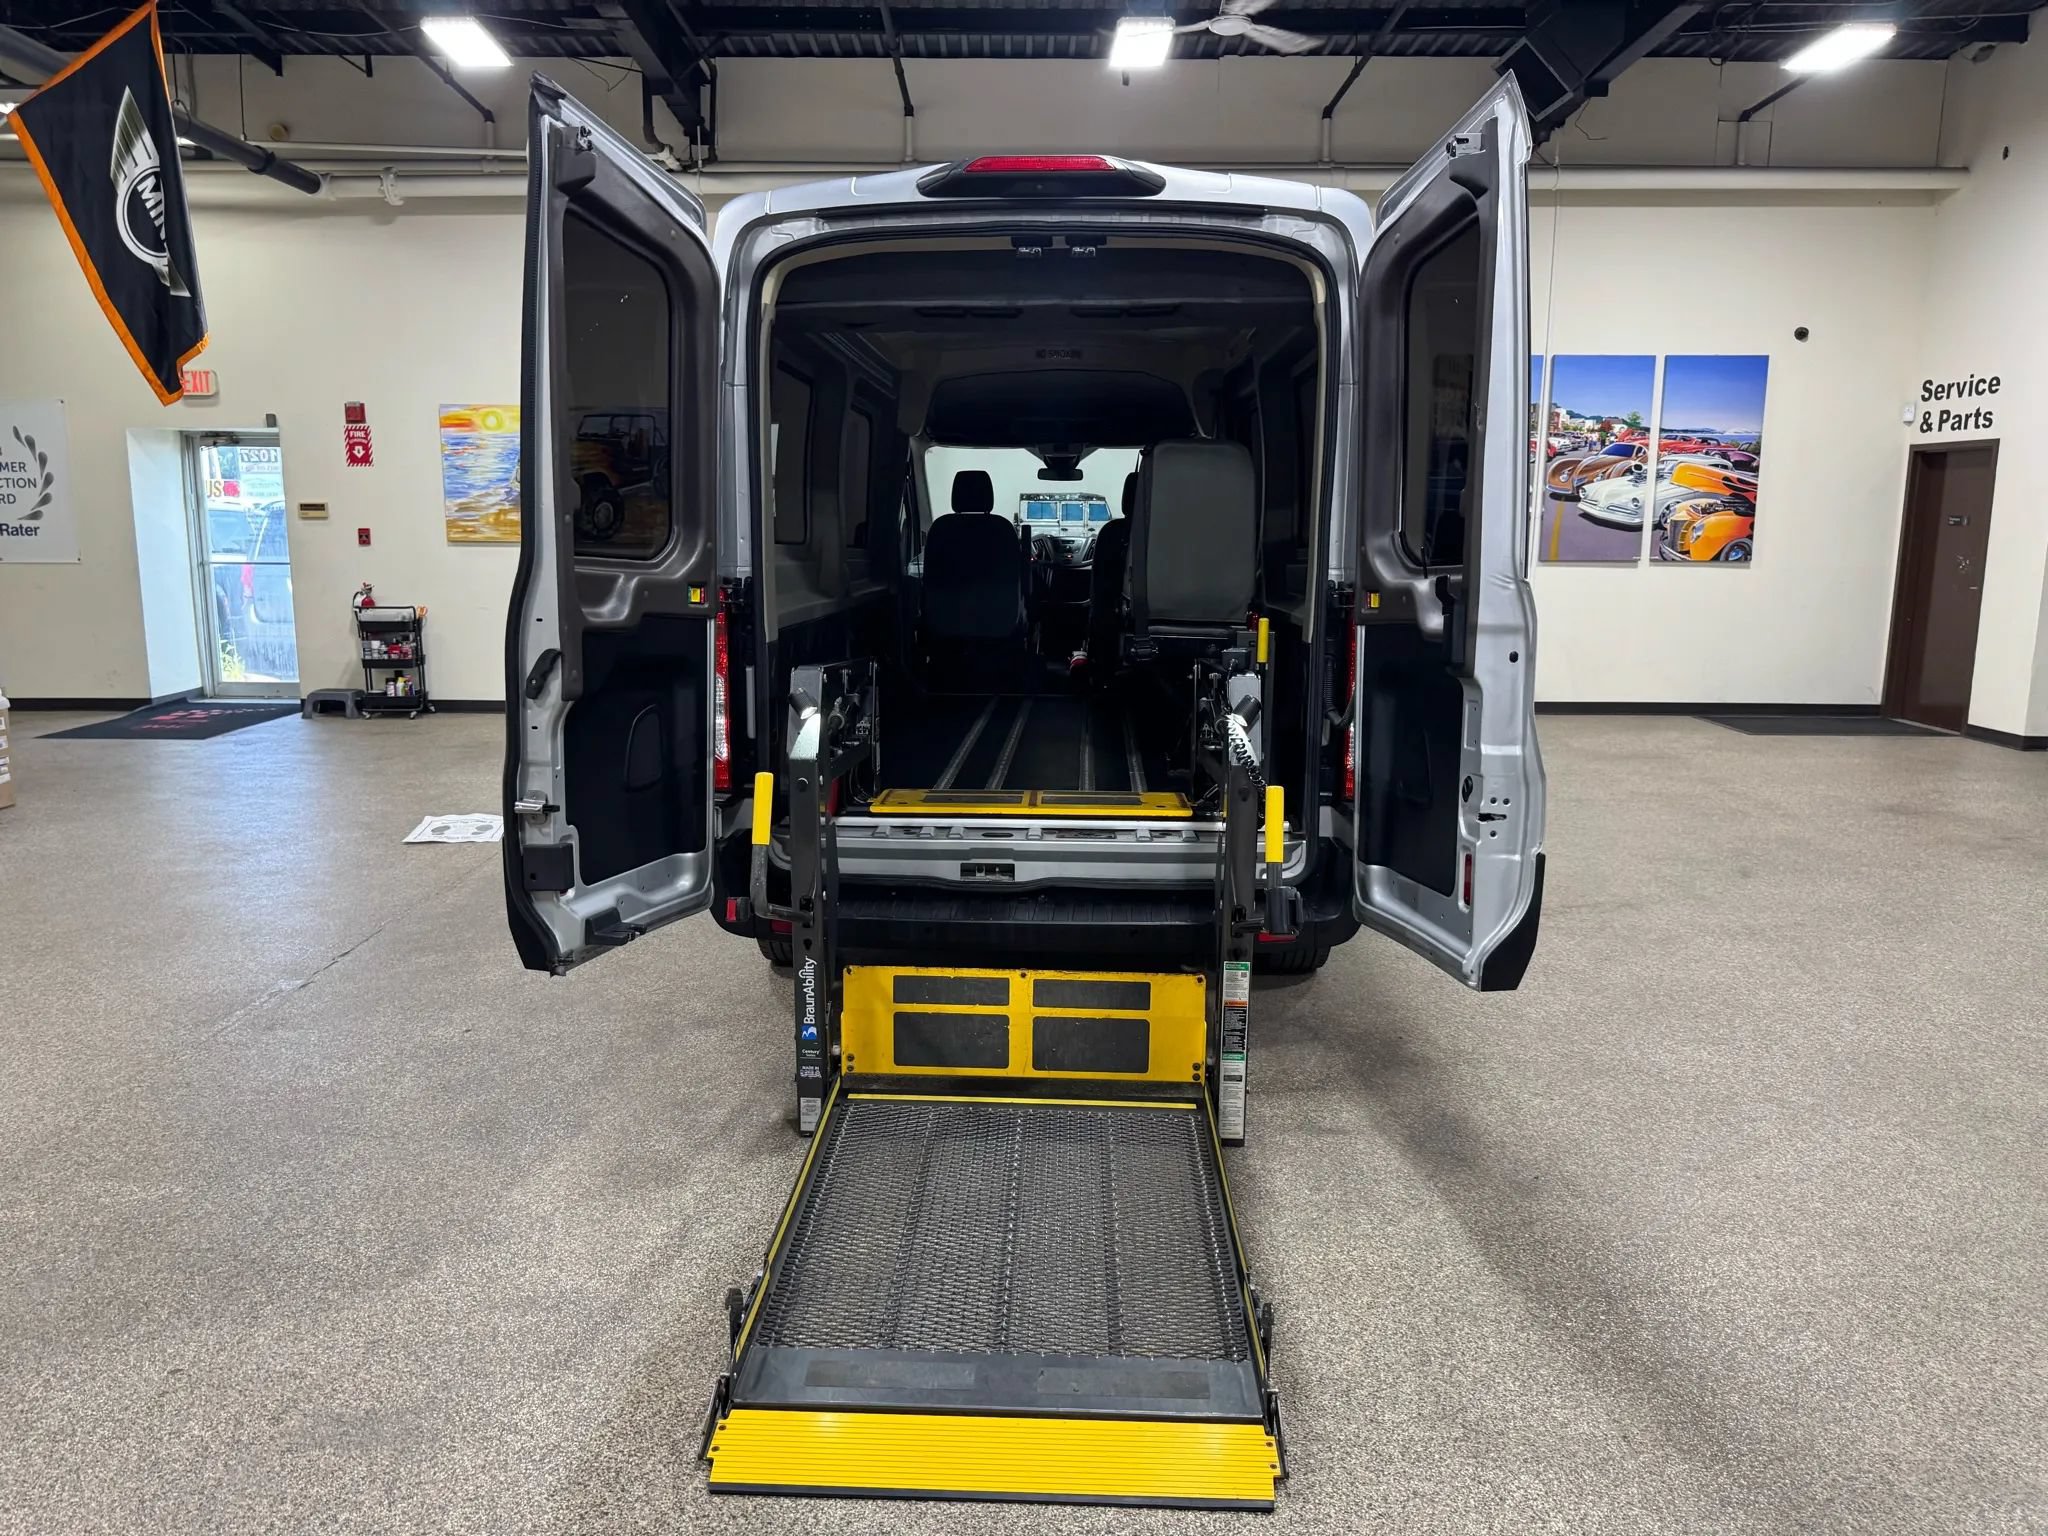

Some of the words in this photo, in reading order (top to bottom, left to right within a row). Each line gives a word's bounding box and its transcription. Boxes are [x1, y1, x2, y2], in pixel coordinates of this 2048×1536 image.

[183, 370, 211, 393] EXIT
[1920, 374, 2001, 402] Service
[1919, 410, 1934, 433] &
[1937, 406, 1994, 432] Parts
[349, 430, 367, 438] FIRE
[798, 957, 818, 1025] BraunAbility
